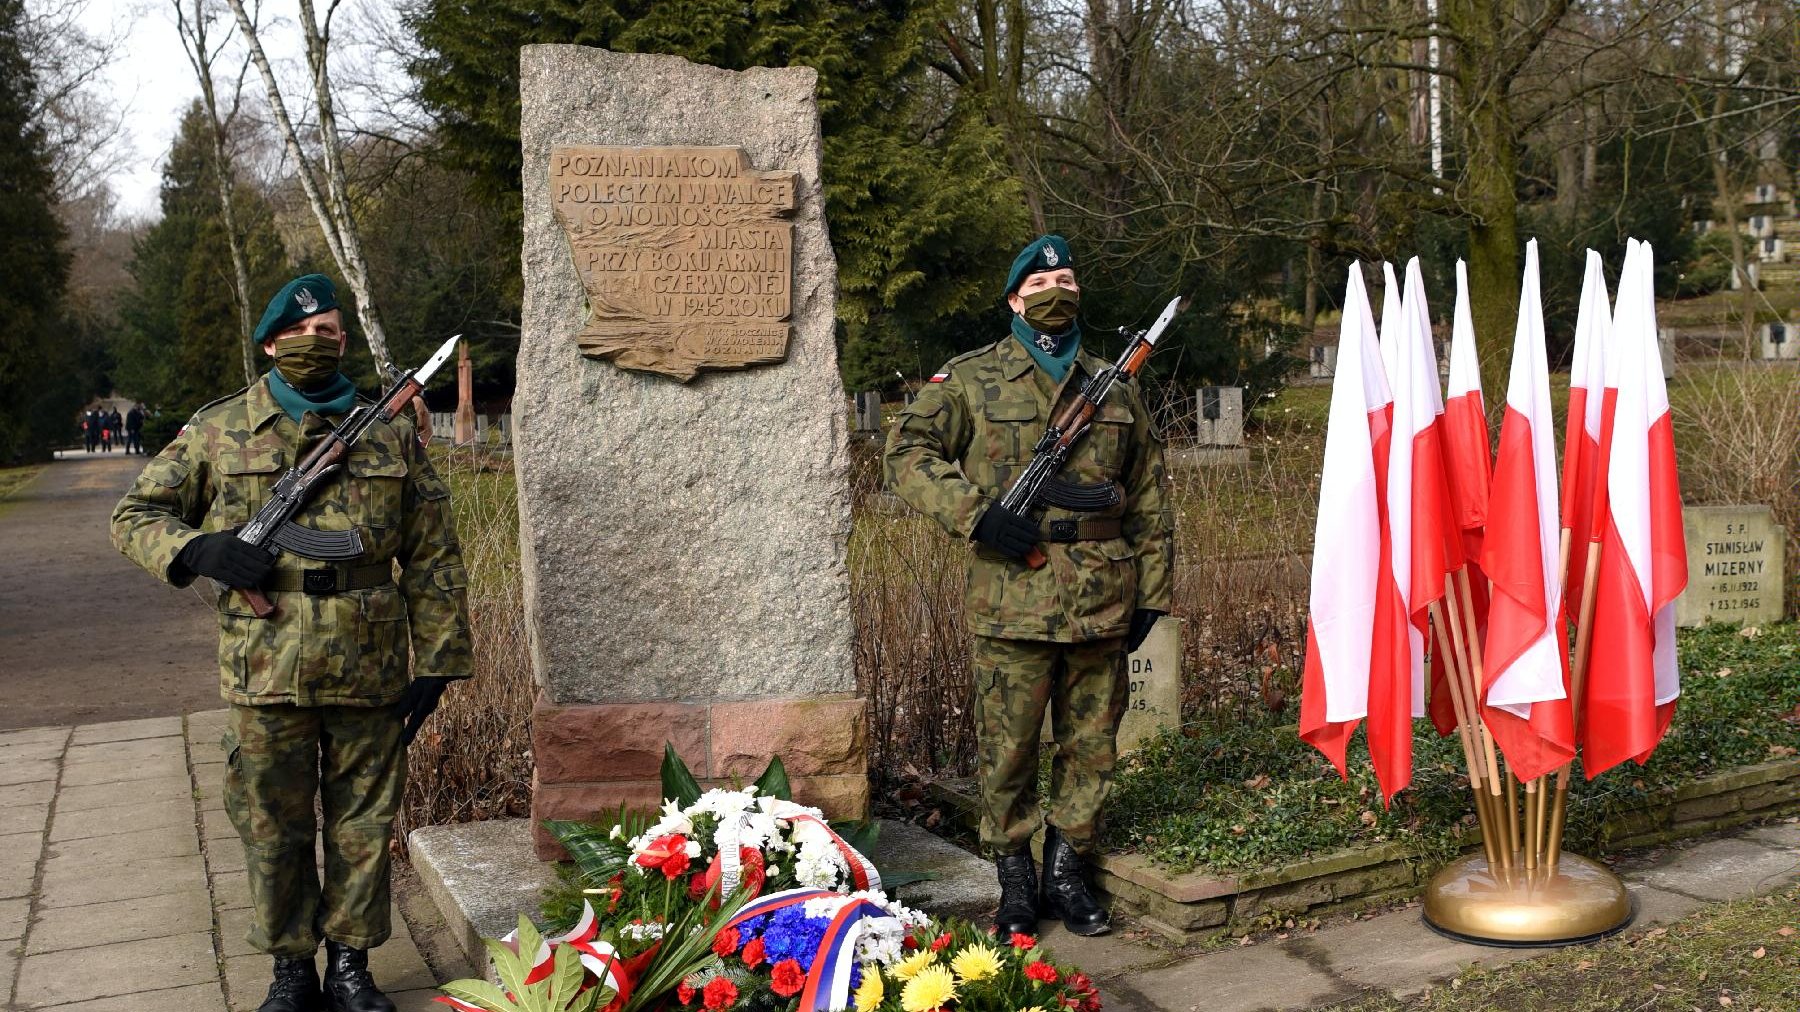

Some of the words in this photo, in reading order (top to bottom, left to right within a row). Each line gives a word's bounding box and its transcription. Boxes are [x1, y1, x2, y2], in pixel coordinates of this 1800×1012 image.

[555, 154, 738, 178] POZNANIAKOM
[687, 183, 707, 204] W
[712, 183, 785, 206] WALCE
[586, 205, 608, 227] O
[699, 228, 784, 250] MIASTA
[585, 251, 641, 272] PRZY
[647, 252, 711, 272] BOKU
[715, 252, 785, 273] ARMII
[652, 274, 785, 295] CZERWONEJ
[653, 296, 672, 317] W
[679, 297, 725, 317] 1945
[726, 297, 785, 318] ROKU
[1706, 541, 1763, 555] STANISŁAW
[1705, 561, 1763, 576] MIZERNY
[1132, 659, 1152, 673] DA
[1130, 681, 1144, 692] 07
[1131, 700, 1145, 710] 45
